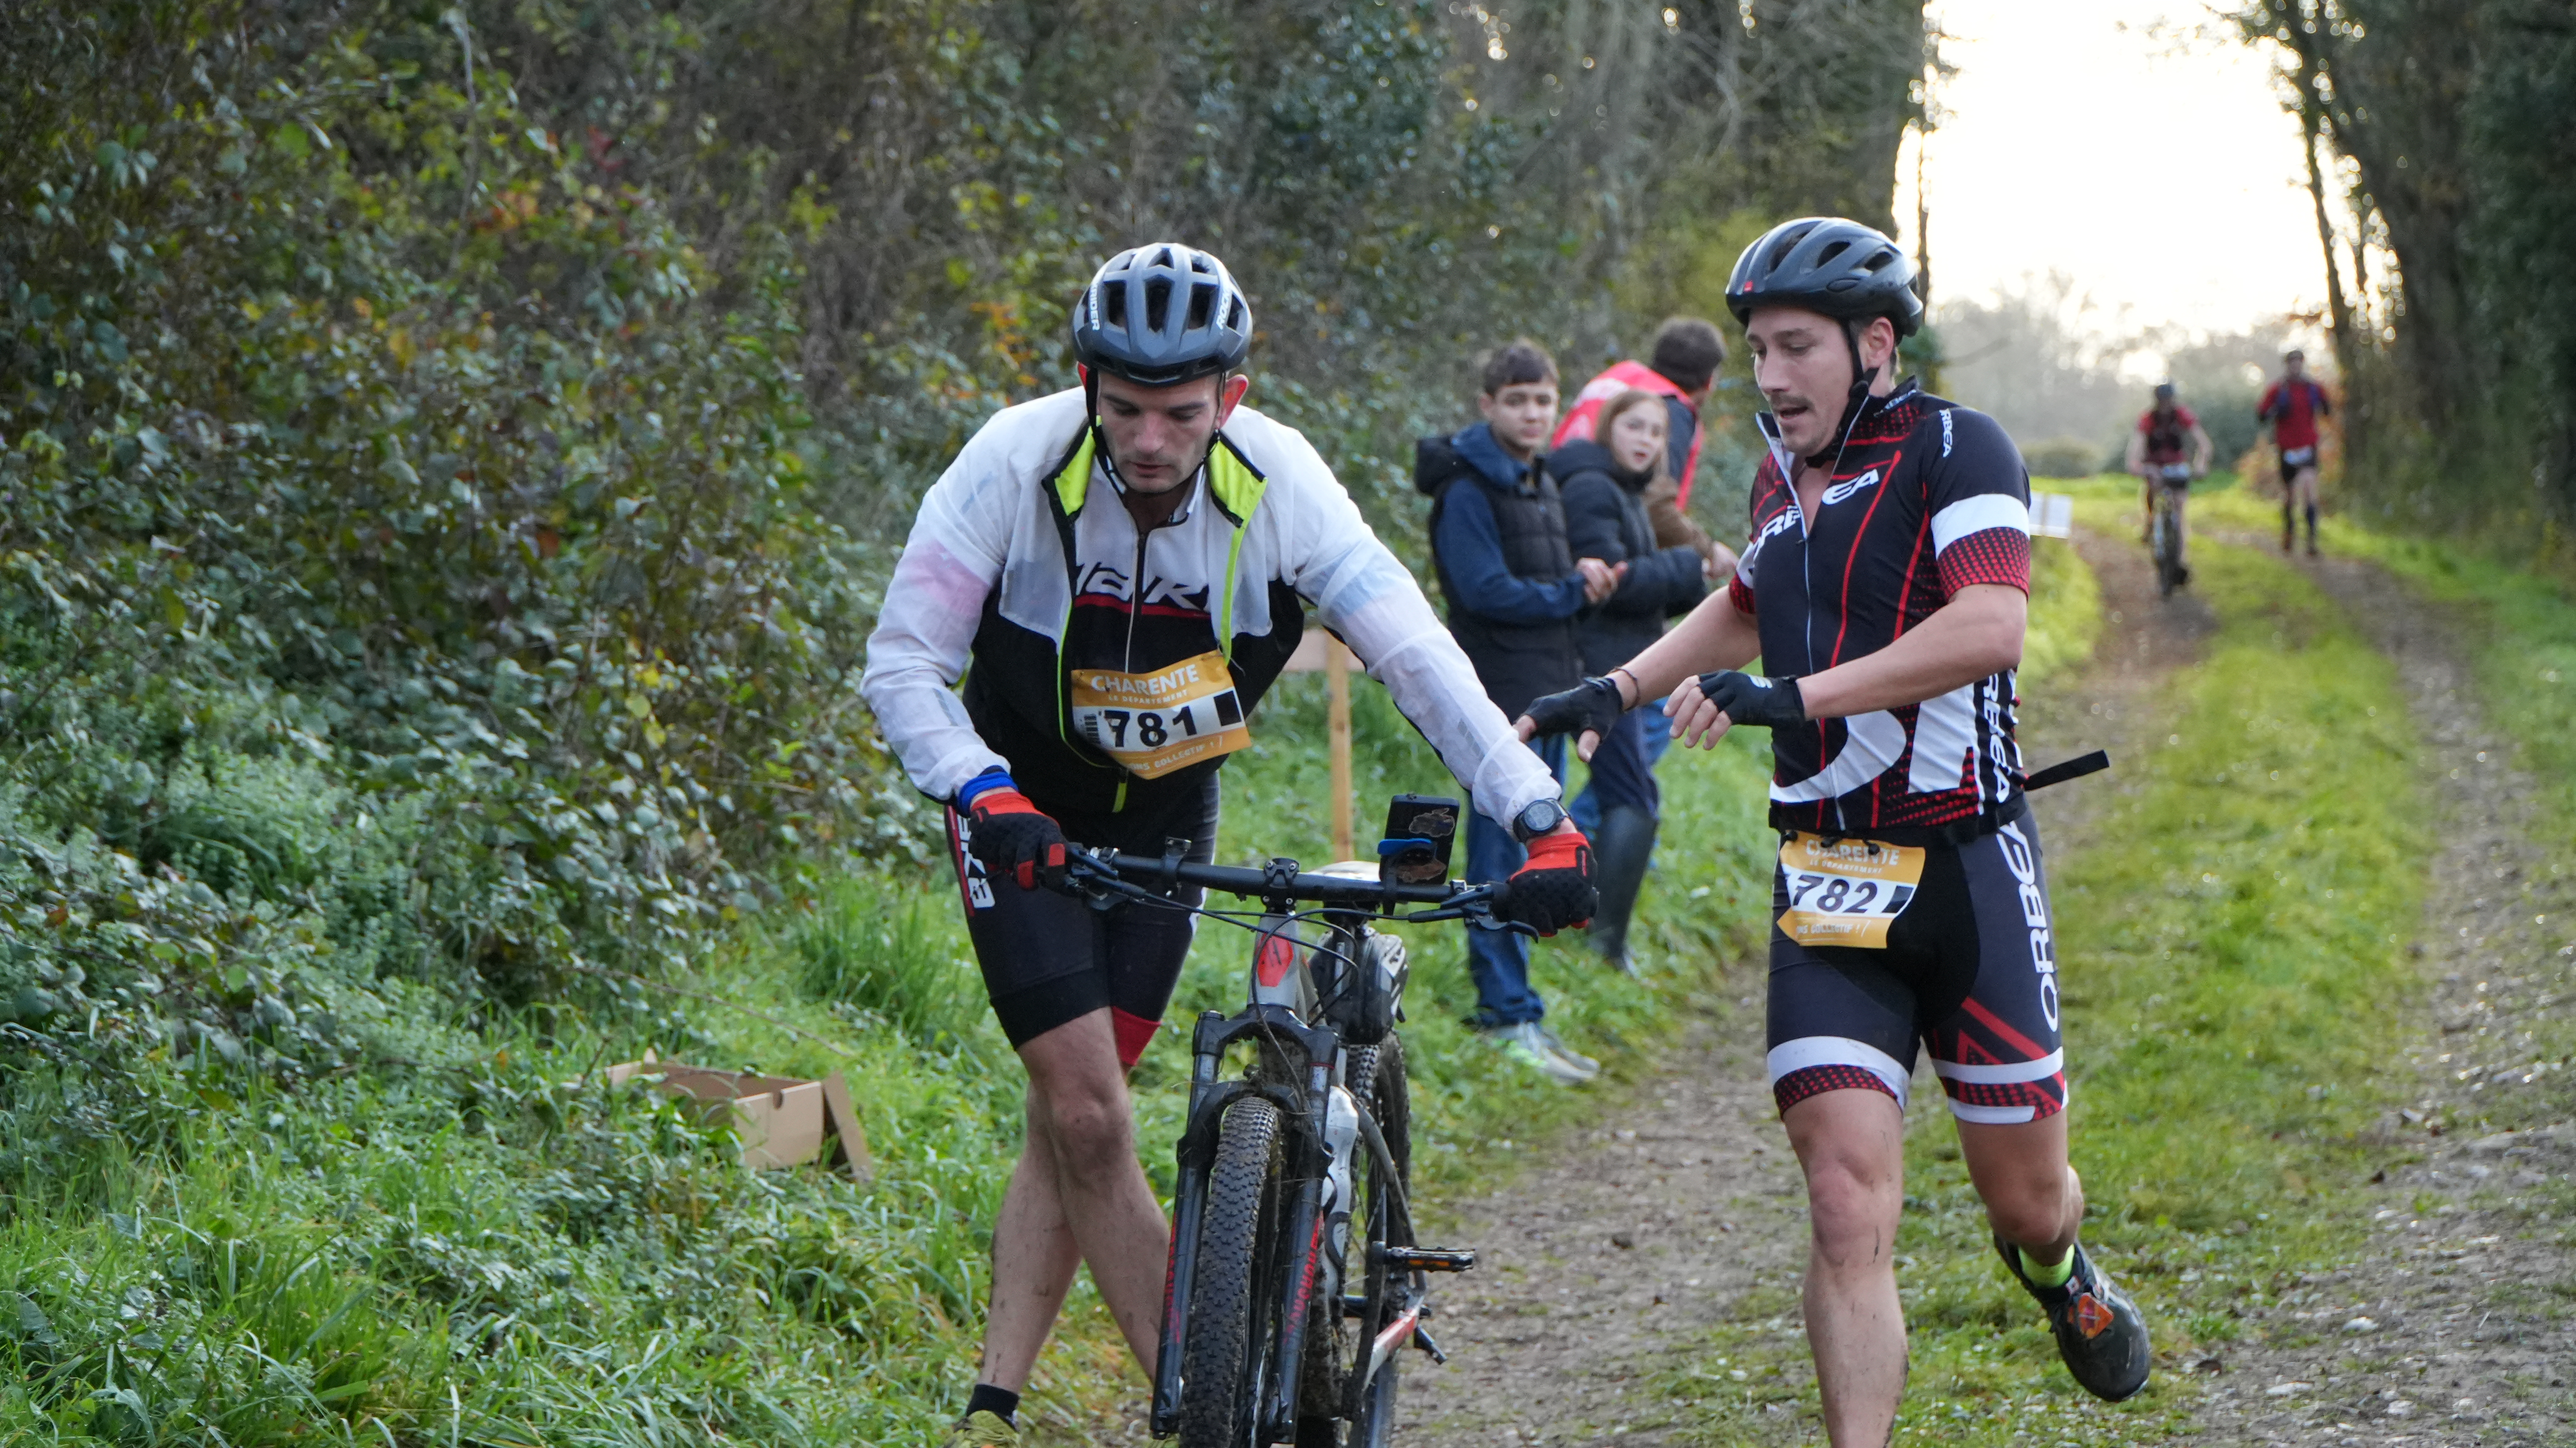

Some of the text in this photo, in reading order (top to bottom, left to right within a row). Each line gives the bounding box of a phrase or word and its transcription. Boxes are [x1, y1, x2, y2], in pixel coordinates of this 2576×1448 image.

[1091, 664, 1199, 696] CHARENTE
[1105, 705, 1198, 748] 781
[1983, 673, 2012, 803] RBEA
[1792, 874, 1878, 914] 782
